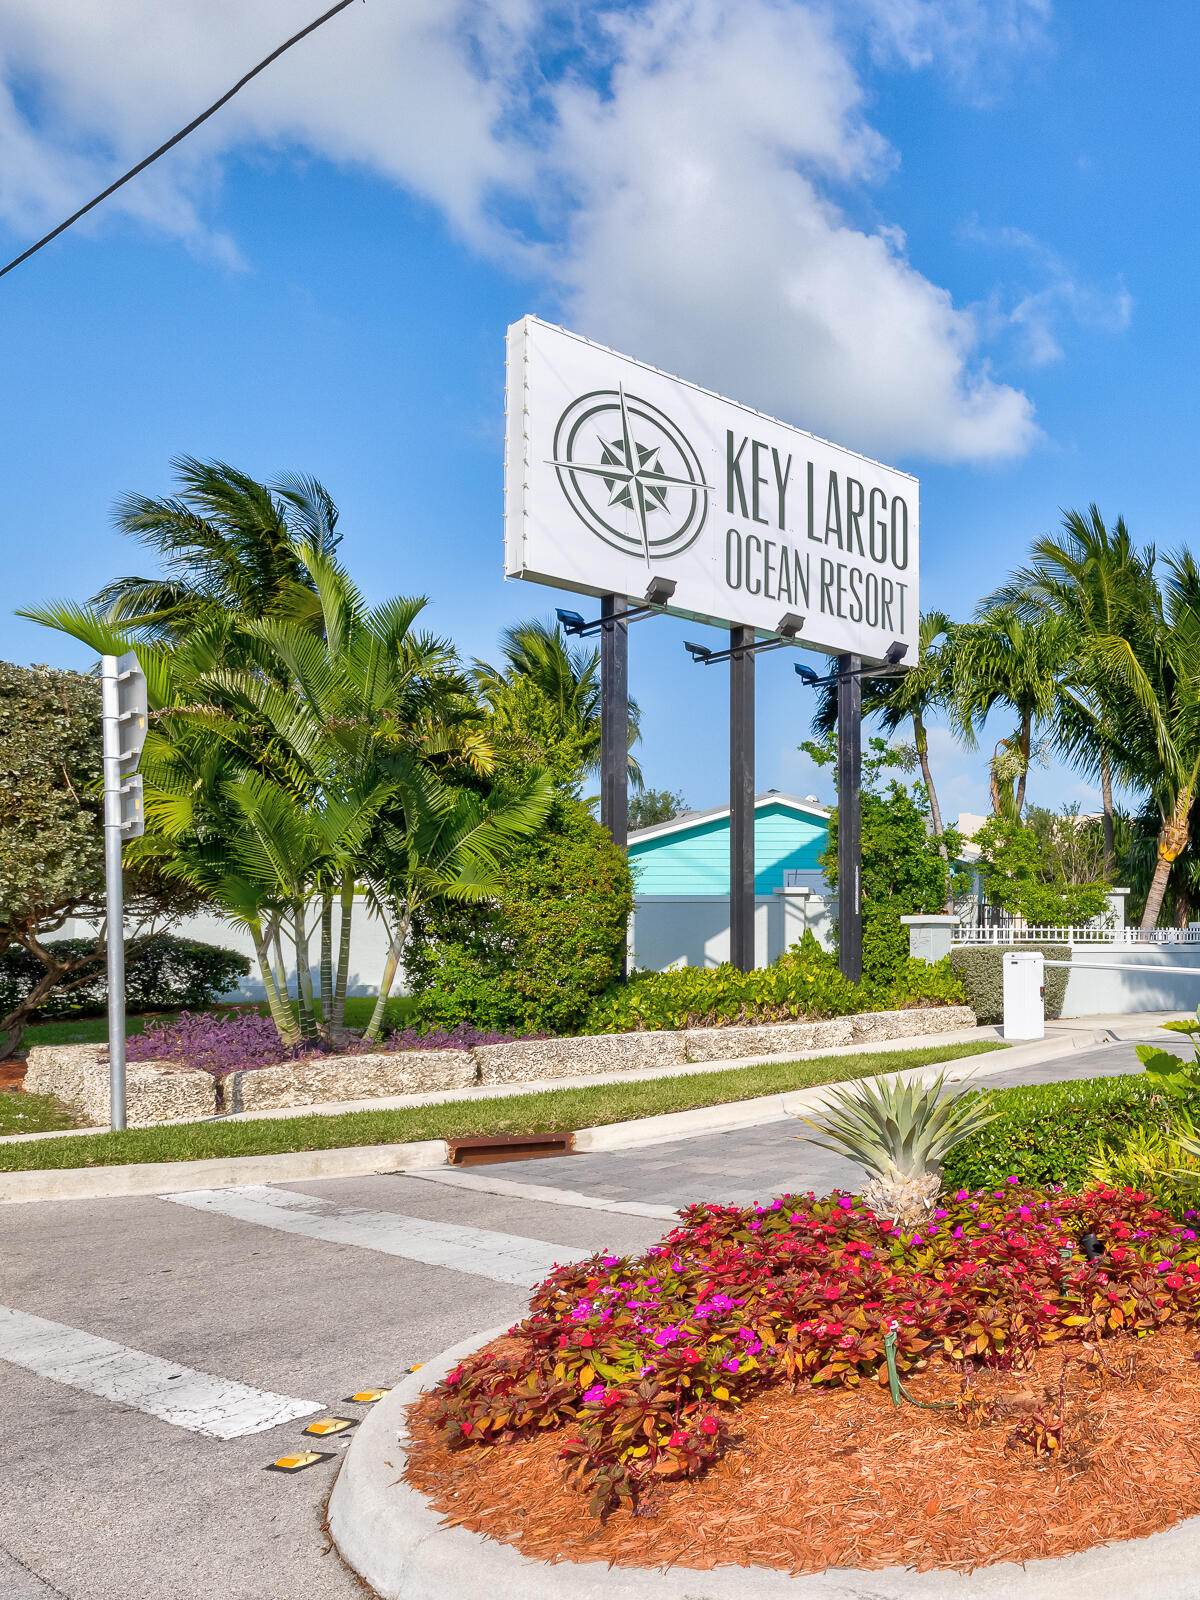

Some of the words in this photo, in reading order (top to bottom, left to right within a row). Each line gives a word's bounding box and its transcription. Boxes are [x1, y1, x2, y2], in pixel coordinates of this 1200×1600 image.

[726, 429, 792, 531] KEY
[807, 461, 908, 570] LARGO
[725, 528, 810, 610] OCEAN
[820, 557, 908, 635] RESORT
